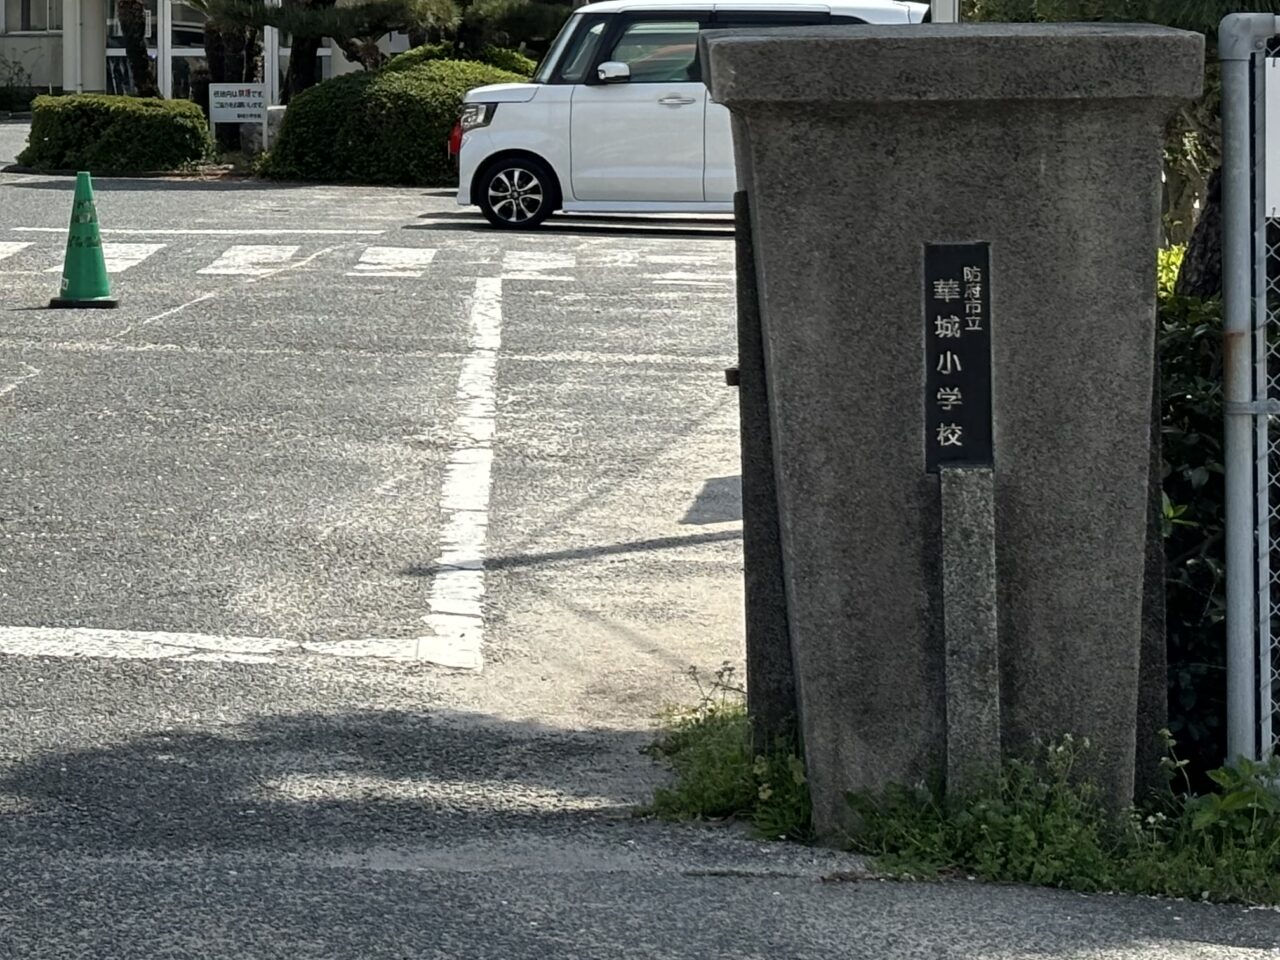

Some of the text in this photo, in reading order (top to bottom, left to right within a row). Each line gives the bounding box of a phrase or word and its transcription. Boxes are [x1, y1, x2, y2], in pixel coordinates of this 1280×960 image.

[963, 266, 983, 331] 防府市立
[933, 278, 963, 447] 華城小学校
